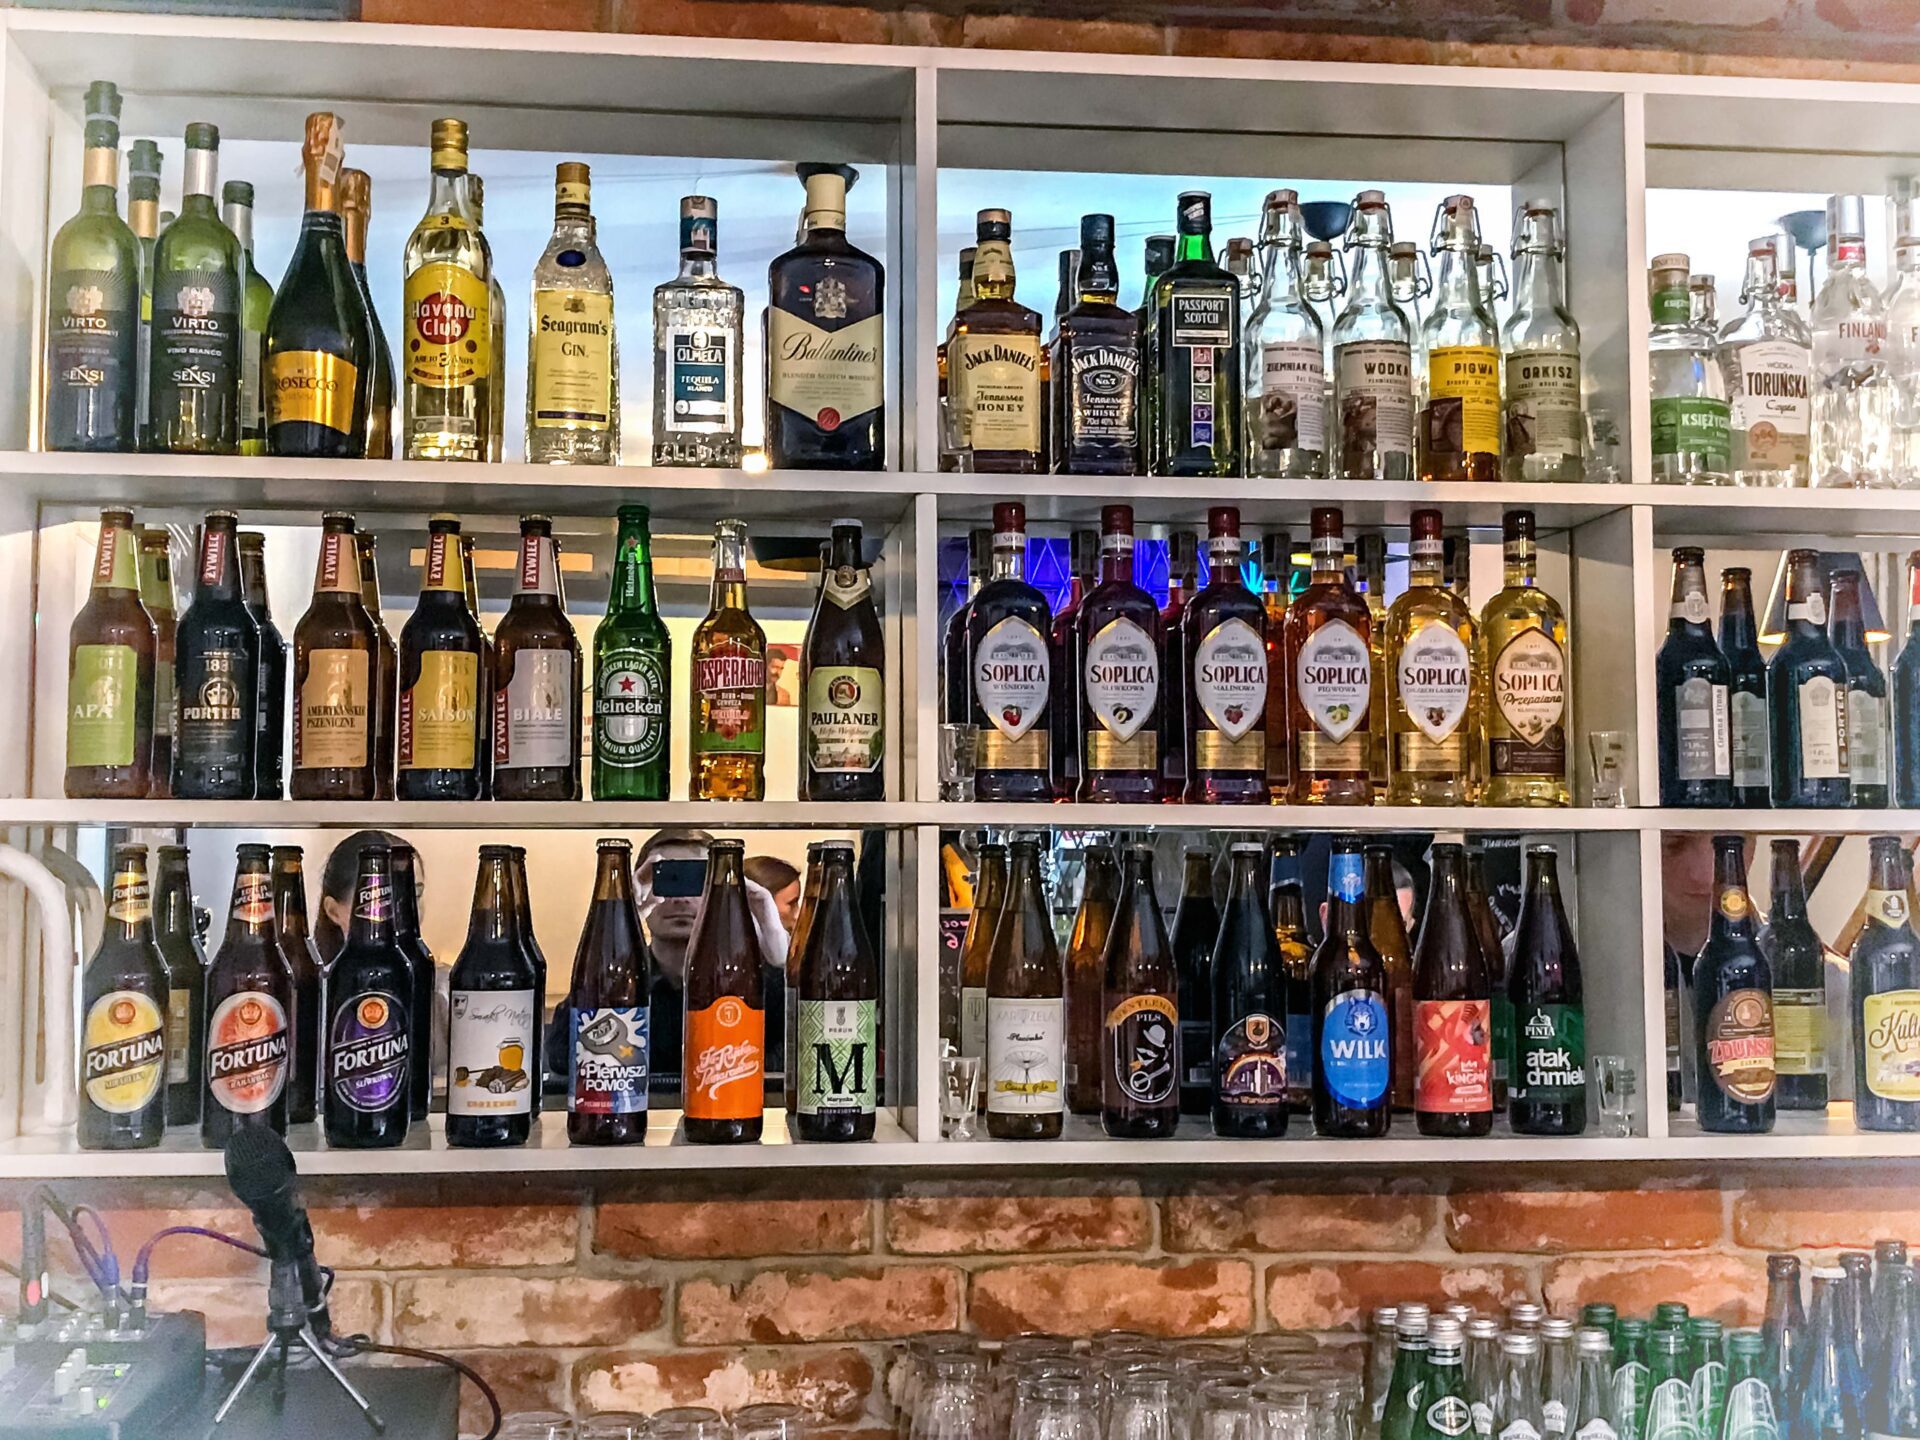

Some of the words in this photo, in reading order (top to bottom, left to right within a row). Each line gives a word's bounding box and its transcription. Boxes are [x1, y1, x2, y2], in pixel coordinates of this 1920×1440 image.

[412, 300, 476, 320] Havana
[1178, 299, 1224, 312] PASSPORT
[62, 316, 107, 328] VIRTO
[172, 316, 218, 330] VIRTO
[540, 314, 608, 336] Seagram's
[1184, 311, 1219, 324] SCOTCH
[423, 319, 462, 337] Club
[676, 347, 723, 363] OLMECA
[777, 332, 877, 366] Ballantine's
[965, 349, 992, 371] JACK
[994, 344, 1036, 373] DANIEL'S
[1072, 354, 1099, 375] JACK
[1099, 349, 1140, 377] DANIEL'S
[1454, 362, 1493, 376] PIGWA
[1522, 366, 1573, 379] ORKISZ
[62, 365, 104, 385] SENSI
[171, 365, 216, 386] SENSI
[274, 376, 338, 393] ROSECCO
[681, 374, 719, 387] TEQUILA
[1746, 371, 1808, 398] TORUŃSKA
[976, 390, 1025, 402] Tennessee
[976, 403, 1025, 412] HONEY
[99, 528, 115, 577] ŻYWIEC
[205, 533, 221, 580] ŻYWIEC
[324, 534, 339, 581] ŻYWIEC
[430, 535, 445, 580] ŻYWIEC
[525, 537, 540, 583] ŻYWIEC
[625, 551, 635, 598] Heineken
[981, 663, 1046, 682] SOPLICA
[1090, 664, 1155, 684] SOPLICA
[1201, 664, 1265, 684] SOPLICA
[1304, 666, 1368, 685] SOPLICA
[1404, 666, 1468, 686] SOPLICA
[1498, 672, 1564, 692] SOPLICA
[993, 682, 1035, 691] WIŚNIOWA
[73, 704, 114, 719] APA
[183, 707, 241, 720] PORTER
[417, 708, 475, 722] SAISON
[595, 699, 662, 714] Heineken
[306, 717, 356, 729] PSZENICZNE
[496, 694, 506, 755] ŻYWIEC
[811, 711, 878, 726] PAULANER
[1838, 690, 1847, 747] PORTER
[1136, 1013, 1162, 1022] PILS
[1525, 1026, 1556, 1037] PINTA
[86, 1034, 163, 1078] FORTUNA
[210, 1035, 287, 1078] FORTUNA
[333, 1034, 409, 1078] FORTUNA
[1329, 1039, 1387, 1059] WILK
[1526, 1047, 1572, 1070] atak
[586, 1063, 647, 1079] Pierwsza
[811, 1043, 868, 1095] M
[1446, 1069, 1488, 1085] KINGPIN
[585, 1079, 635, 1091] POMOC
